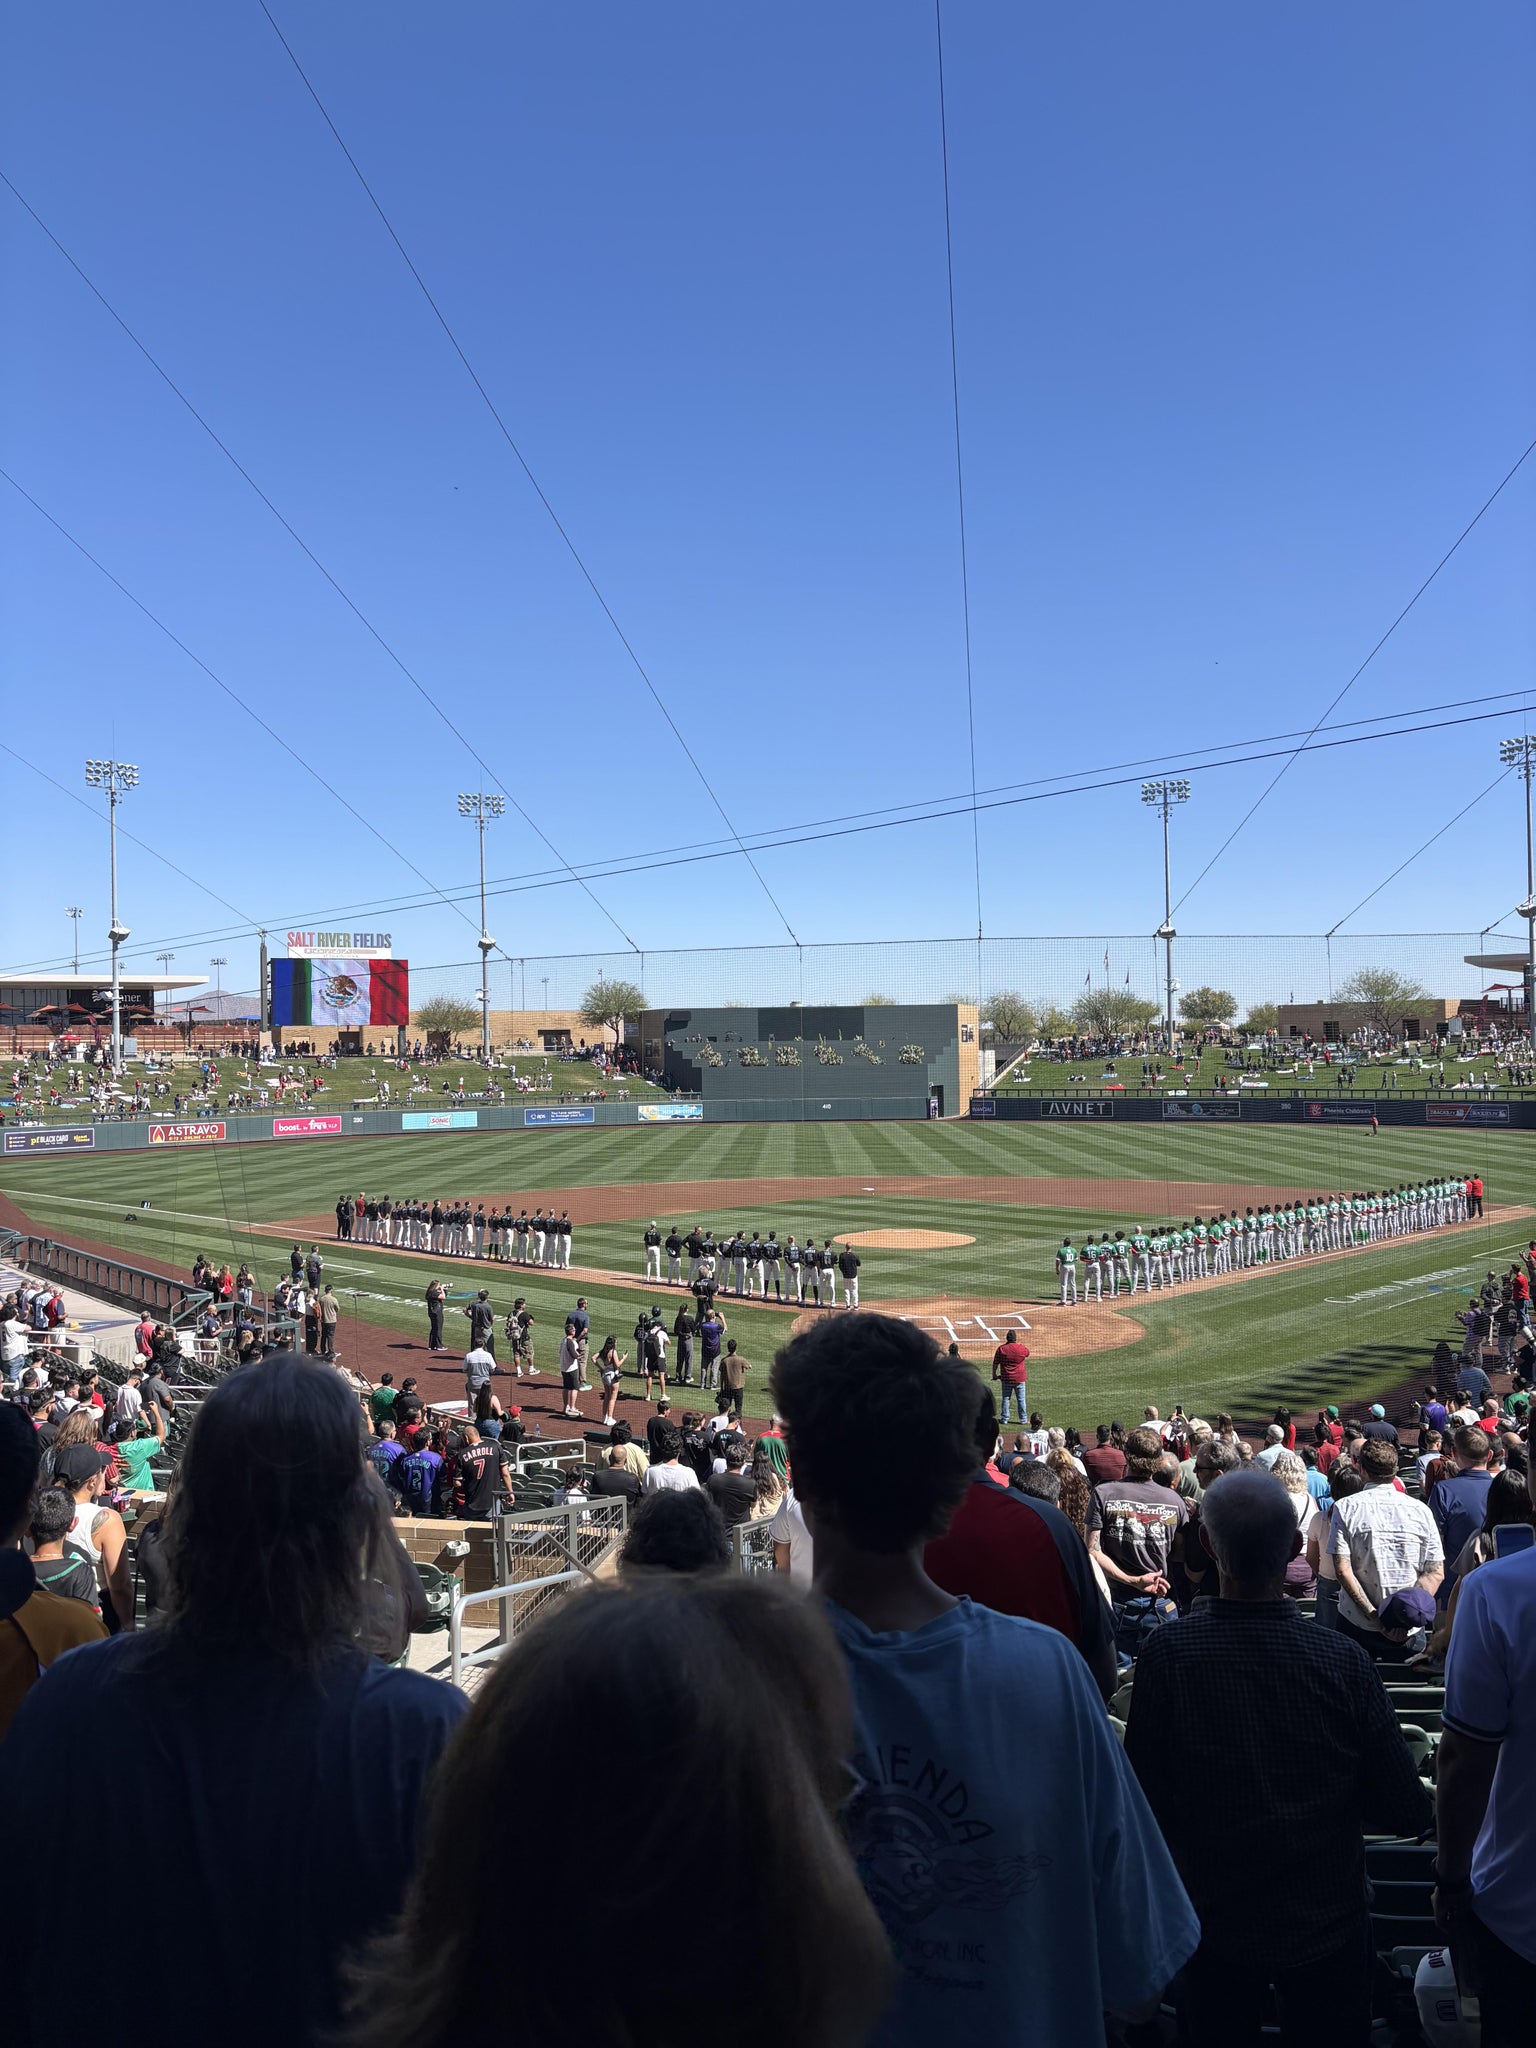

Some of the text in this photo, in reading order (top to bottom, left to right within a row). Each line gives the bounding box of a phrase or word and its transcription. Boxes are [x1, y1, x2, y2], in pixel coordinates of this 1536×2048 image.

[287, 931, 392, 948] SALT RIVER FIELDS
[1049, 1102, 1105, 1115] AVNET
[168, 1125, 219, 1136] ASTRAVO
[40, 1135, 55, 1143] BLACK
[1134, 1239, 1146, 1249] 44
[462, 1446, 494, 1462] CARROLL
[473, 1458, 485, 1480] 7
[412, 1469, 422, 1491] 2
